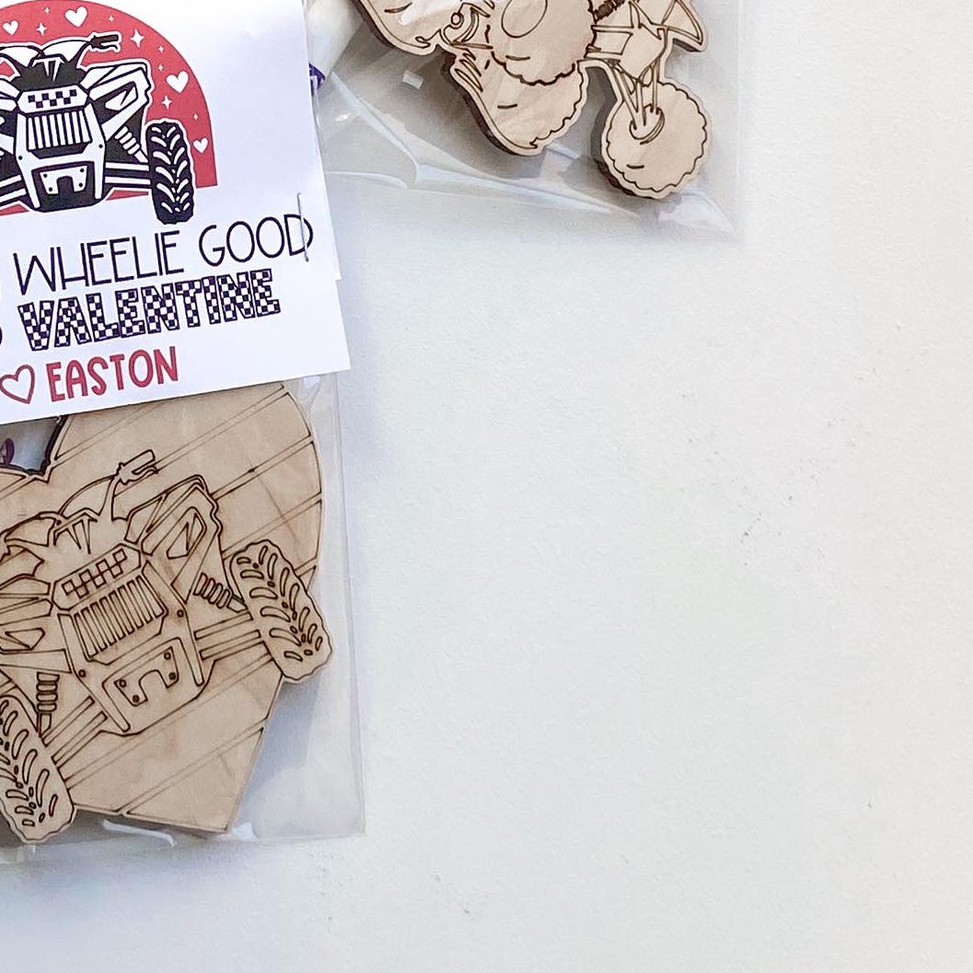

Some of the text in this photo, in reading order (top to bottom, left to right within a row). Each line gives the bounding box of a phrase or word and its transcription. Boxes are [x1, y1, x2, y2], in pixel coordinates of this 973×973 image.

[12, 229, 185, 296] WHEELIE
[198, 214, 314, 266] GOOD
[17, 268, 281, 352] VALENTINE
[46, 345, 179, 402] EASTON
